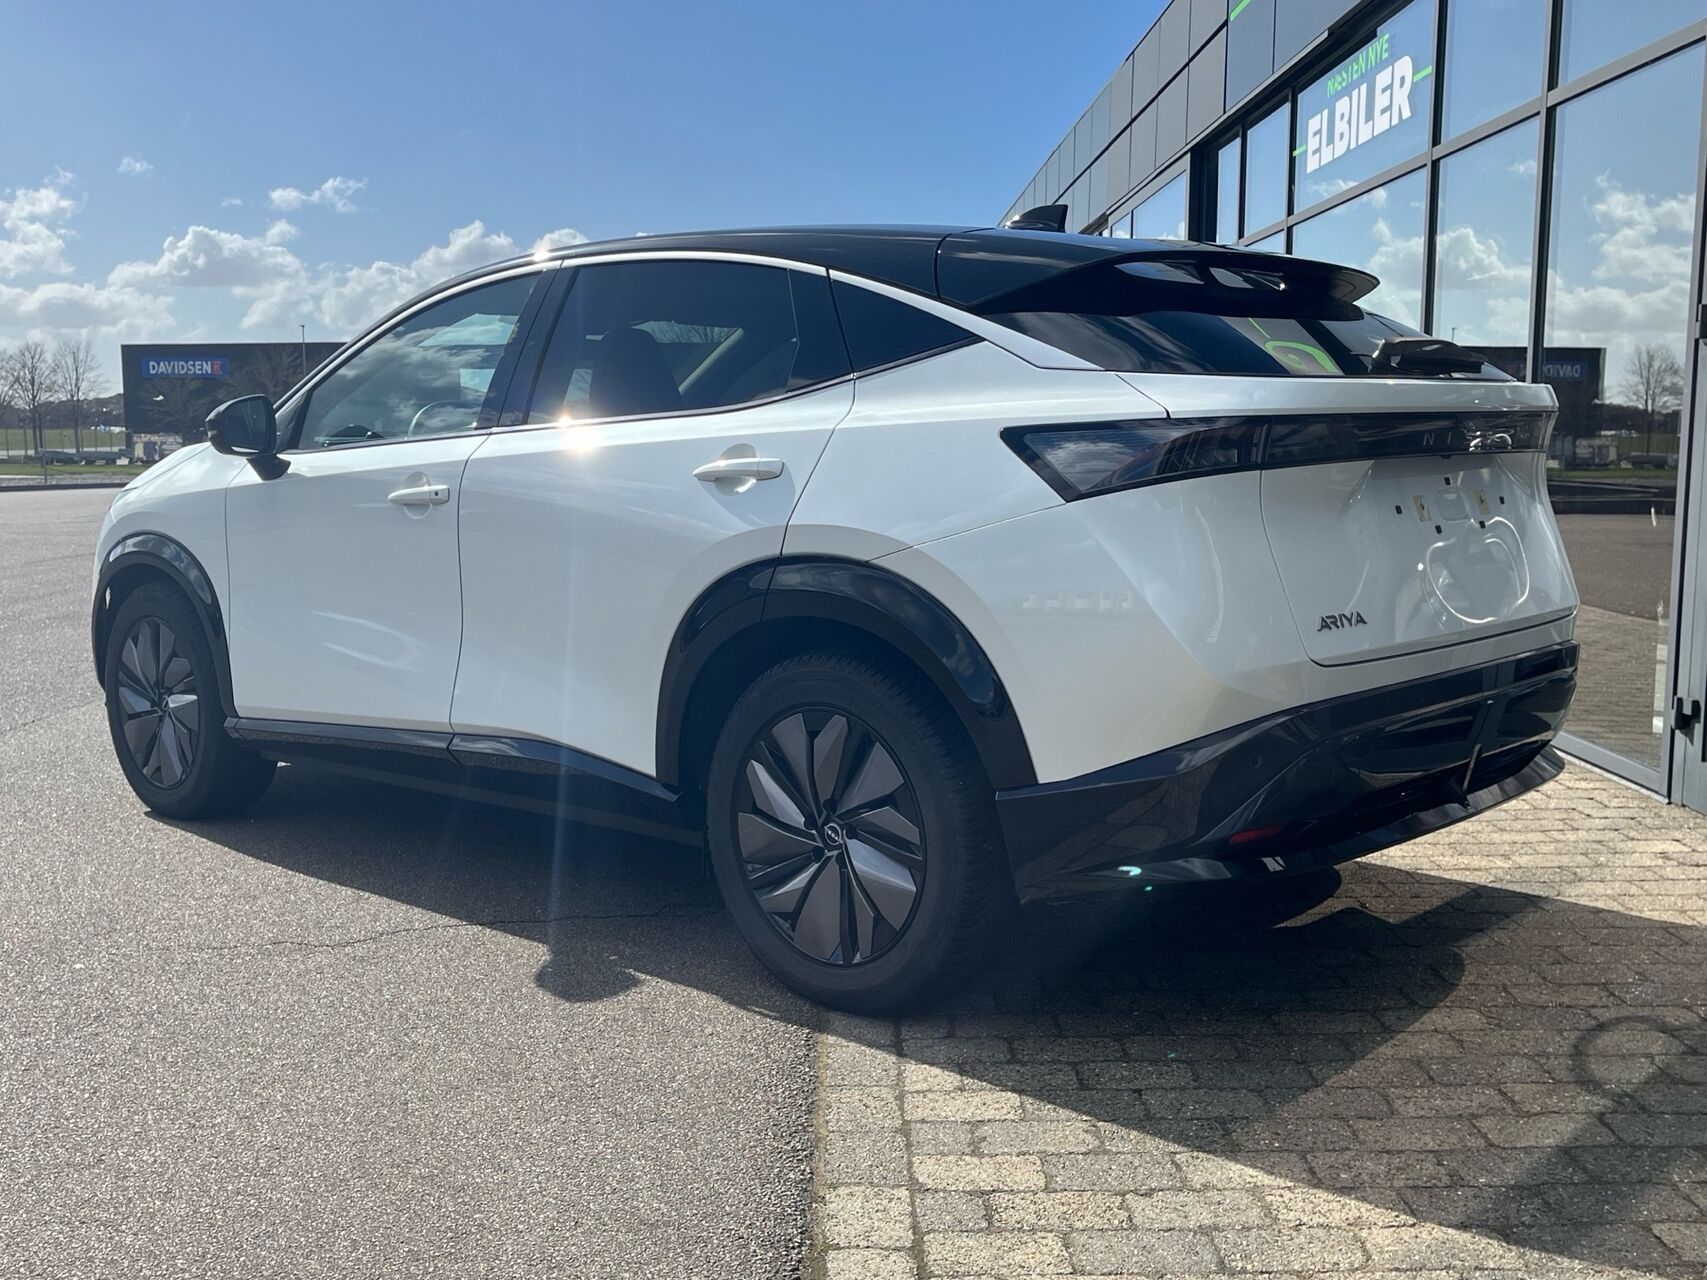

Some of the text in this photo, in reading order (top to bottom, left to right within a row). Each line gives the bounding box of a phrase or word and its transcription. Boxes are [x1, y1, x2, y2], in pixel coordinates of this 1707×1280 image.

[1368, 32, 1390, 70] NYE
[1306, 55, 1413, 174] ELBILER
[148, 360, 212, 375] DAVIDSEN
[1317, 611, 1368, 632] ARIYA
